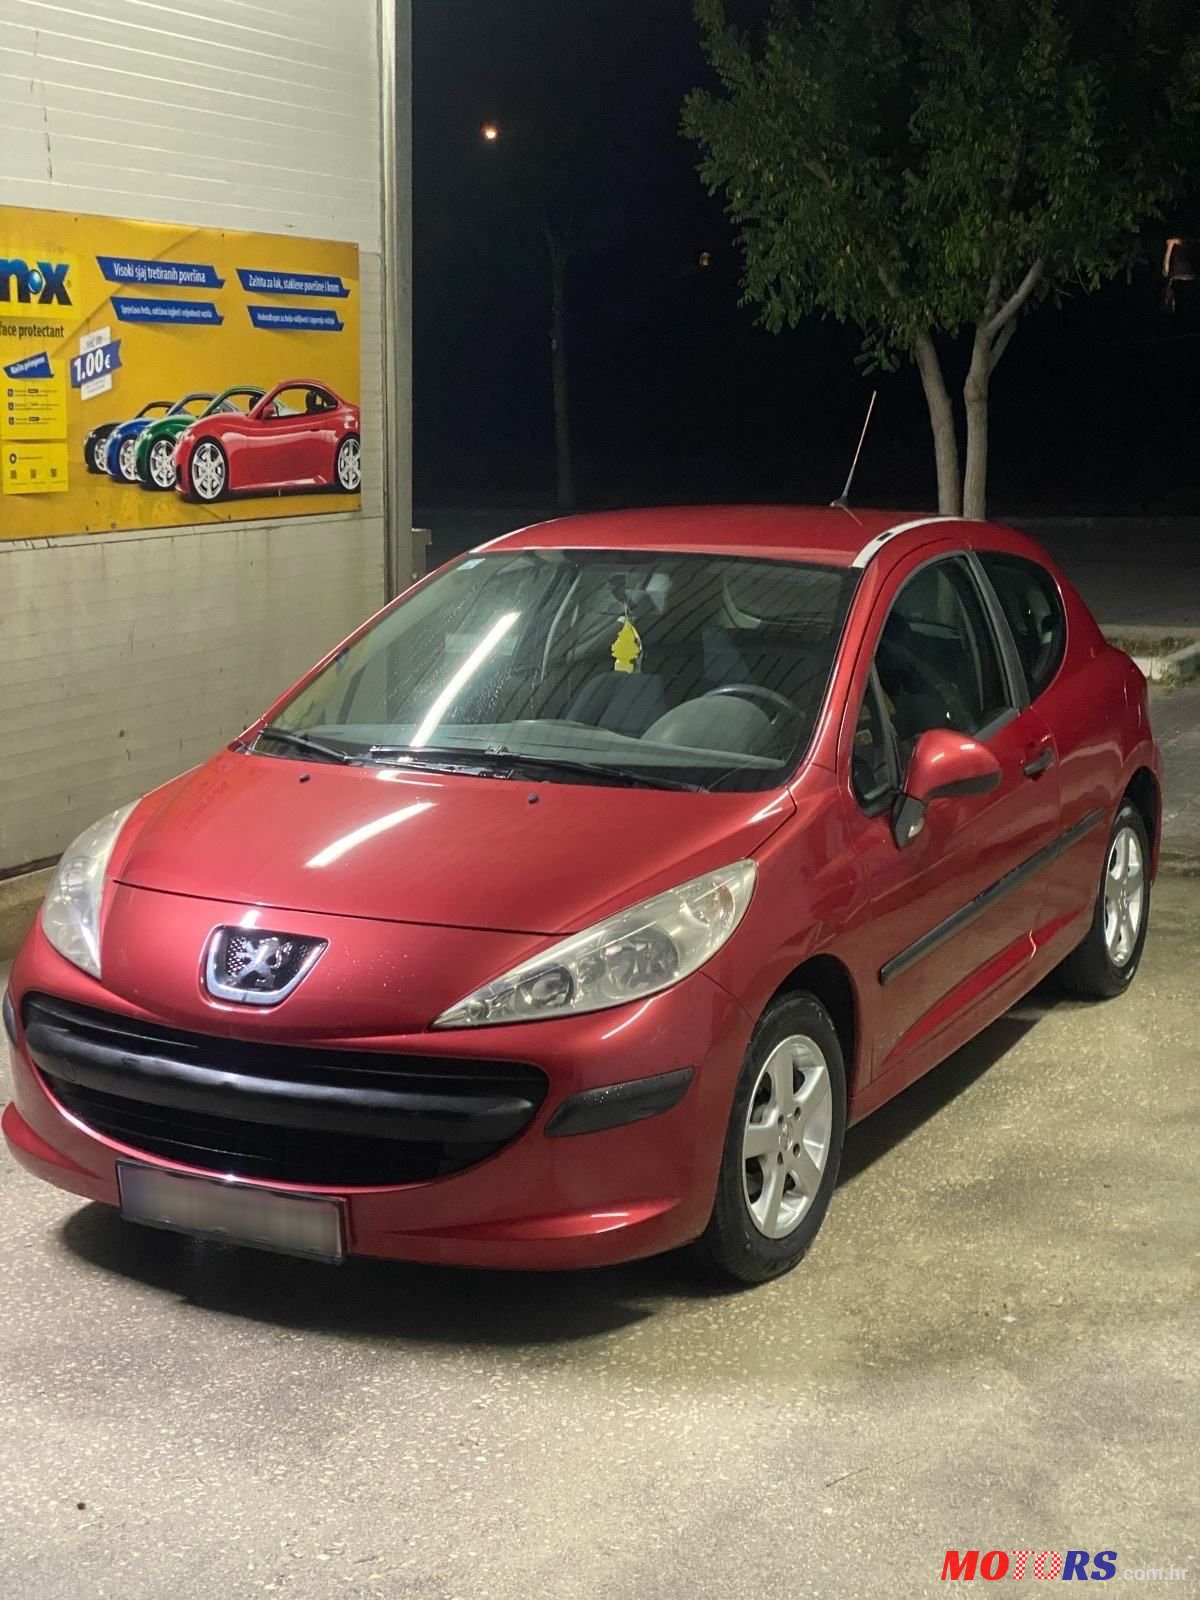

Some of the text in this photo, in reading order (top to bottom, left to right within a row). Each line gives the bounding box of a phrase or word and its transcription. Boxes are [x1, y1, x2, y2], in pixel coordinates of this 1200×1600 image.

[113, 262, 206, 284] Visoki sjaj tretiranih površina
[19, 325, 64, 340] protectant
